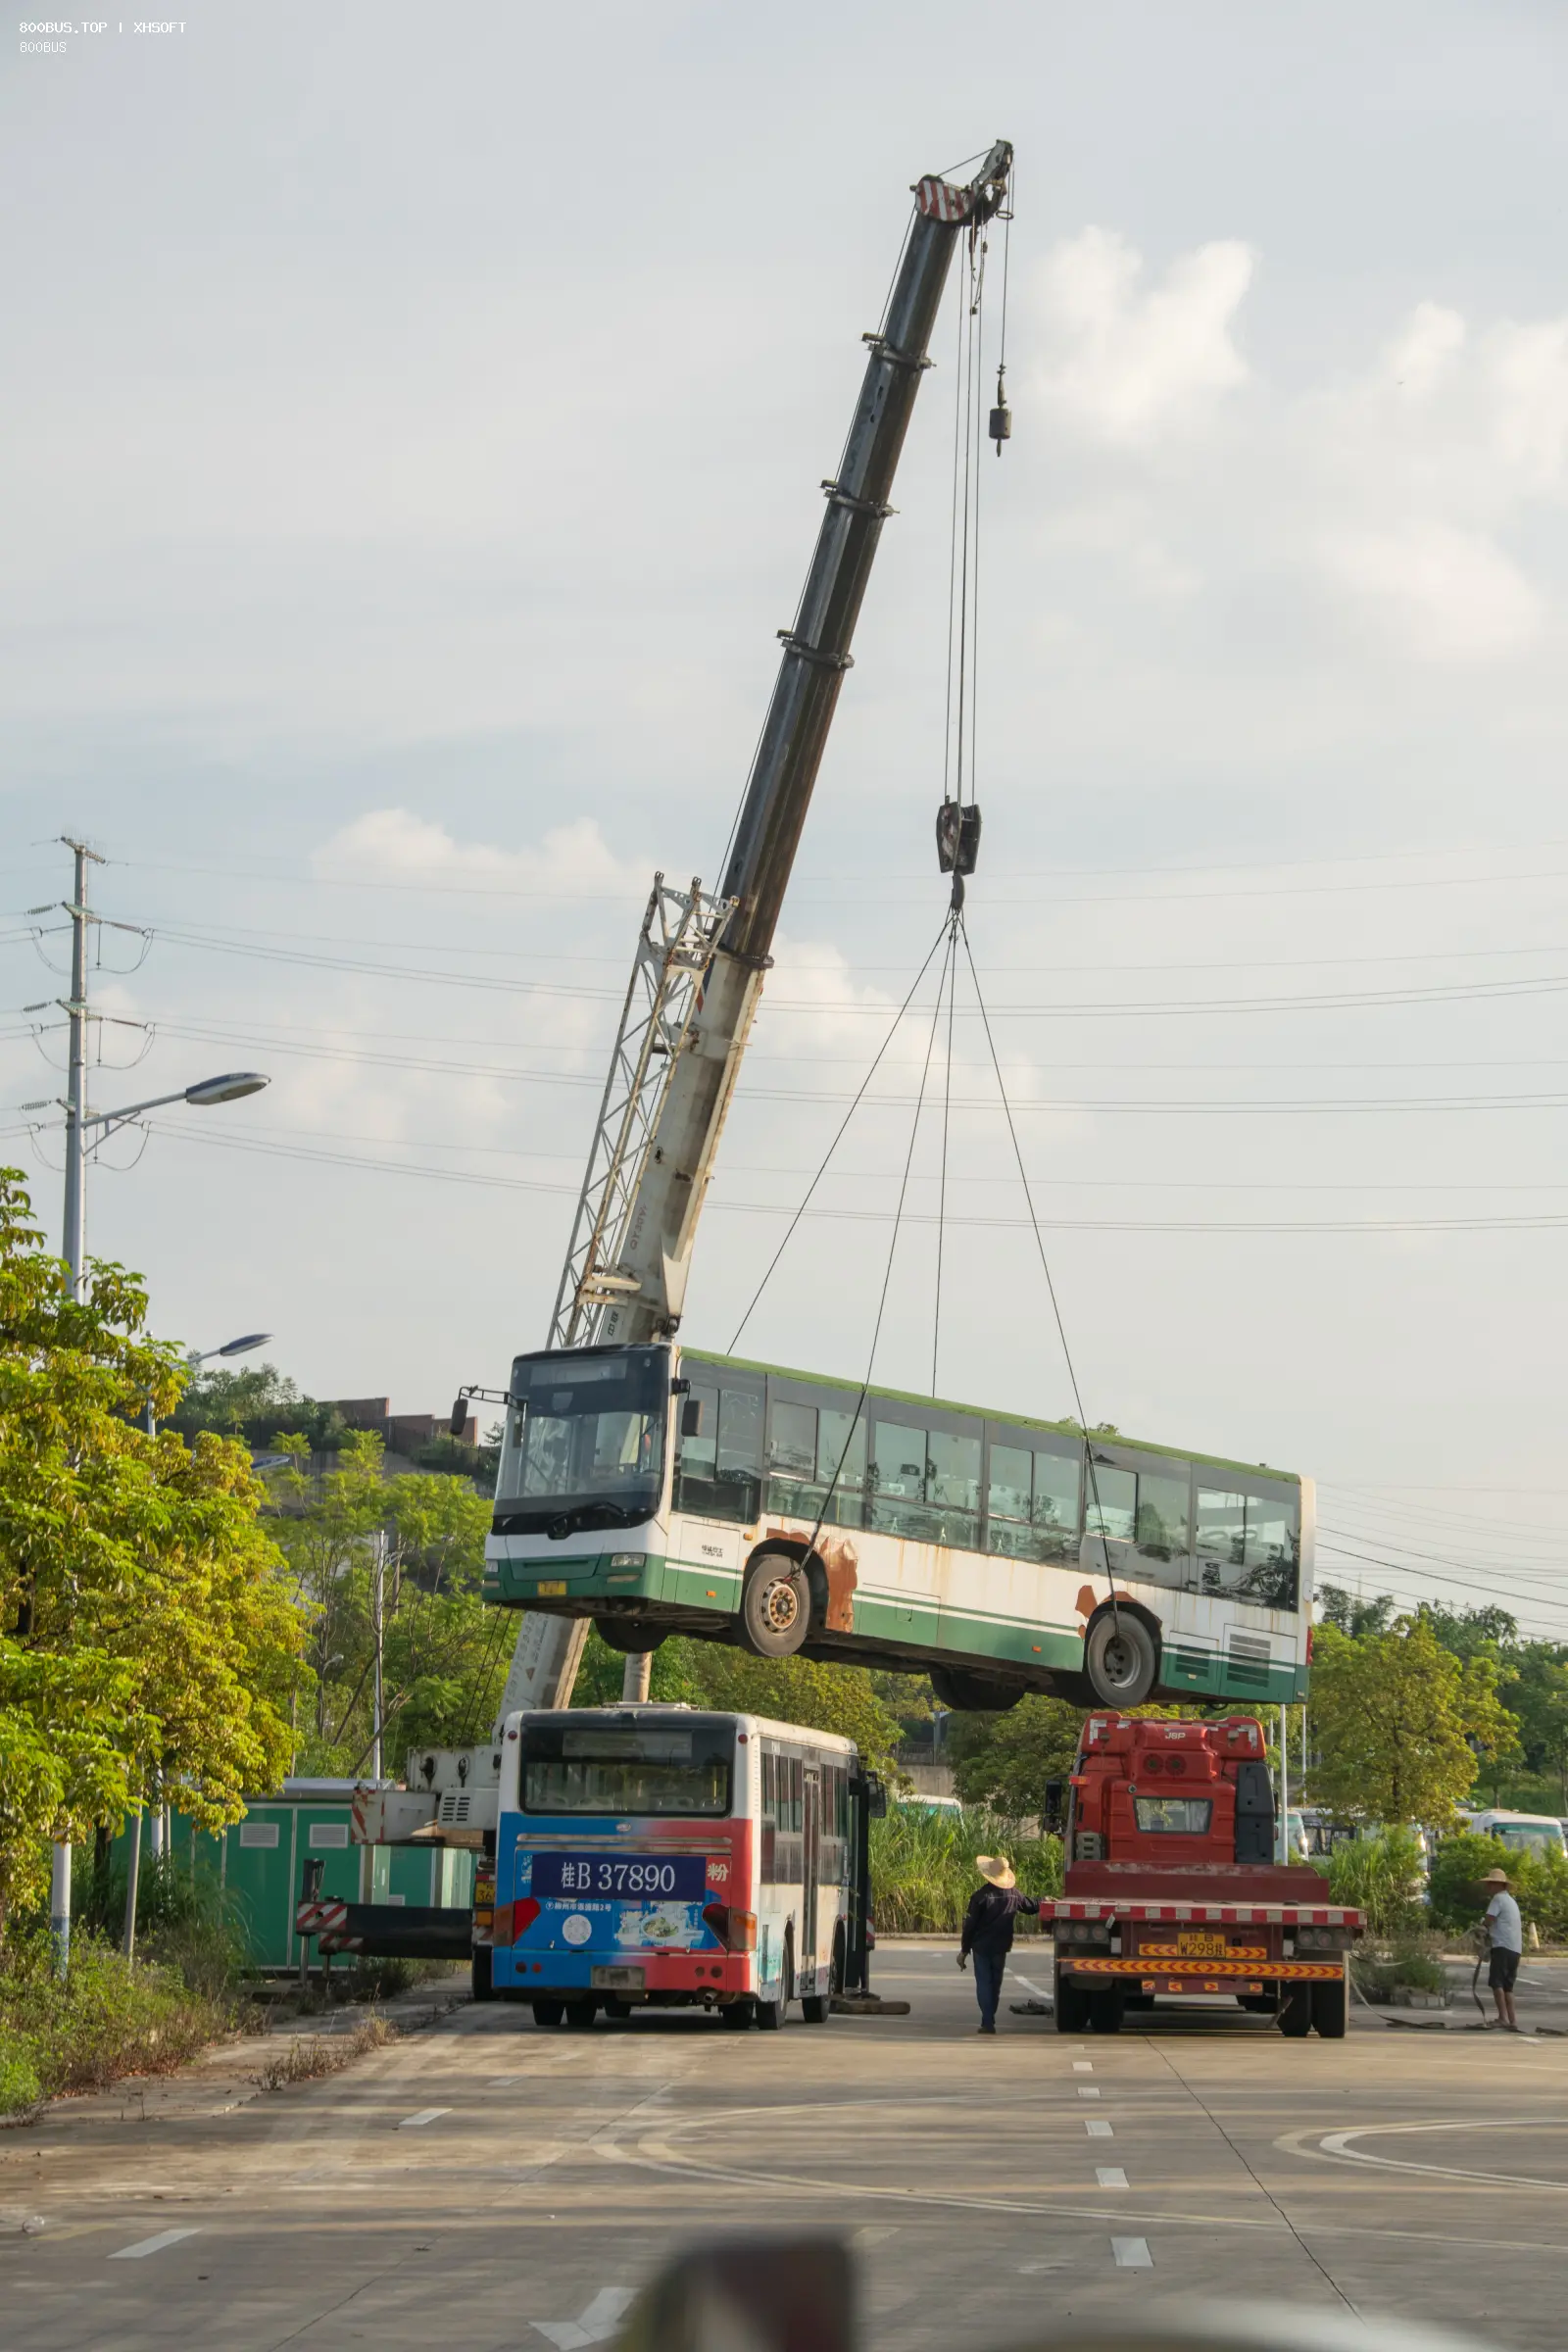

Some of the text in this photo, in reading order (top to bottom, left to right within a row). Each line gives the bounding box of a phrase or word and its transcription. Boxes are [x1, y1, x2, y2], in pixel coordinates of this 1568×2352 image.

[562, 1862, 591, 1889] 桂B
[598, 1863, 676, 1892] 37890
[707, 1862, 729, 1882] 粉
